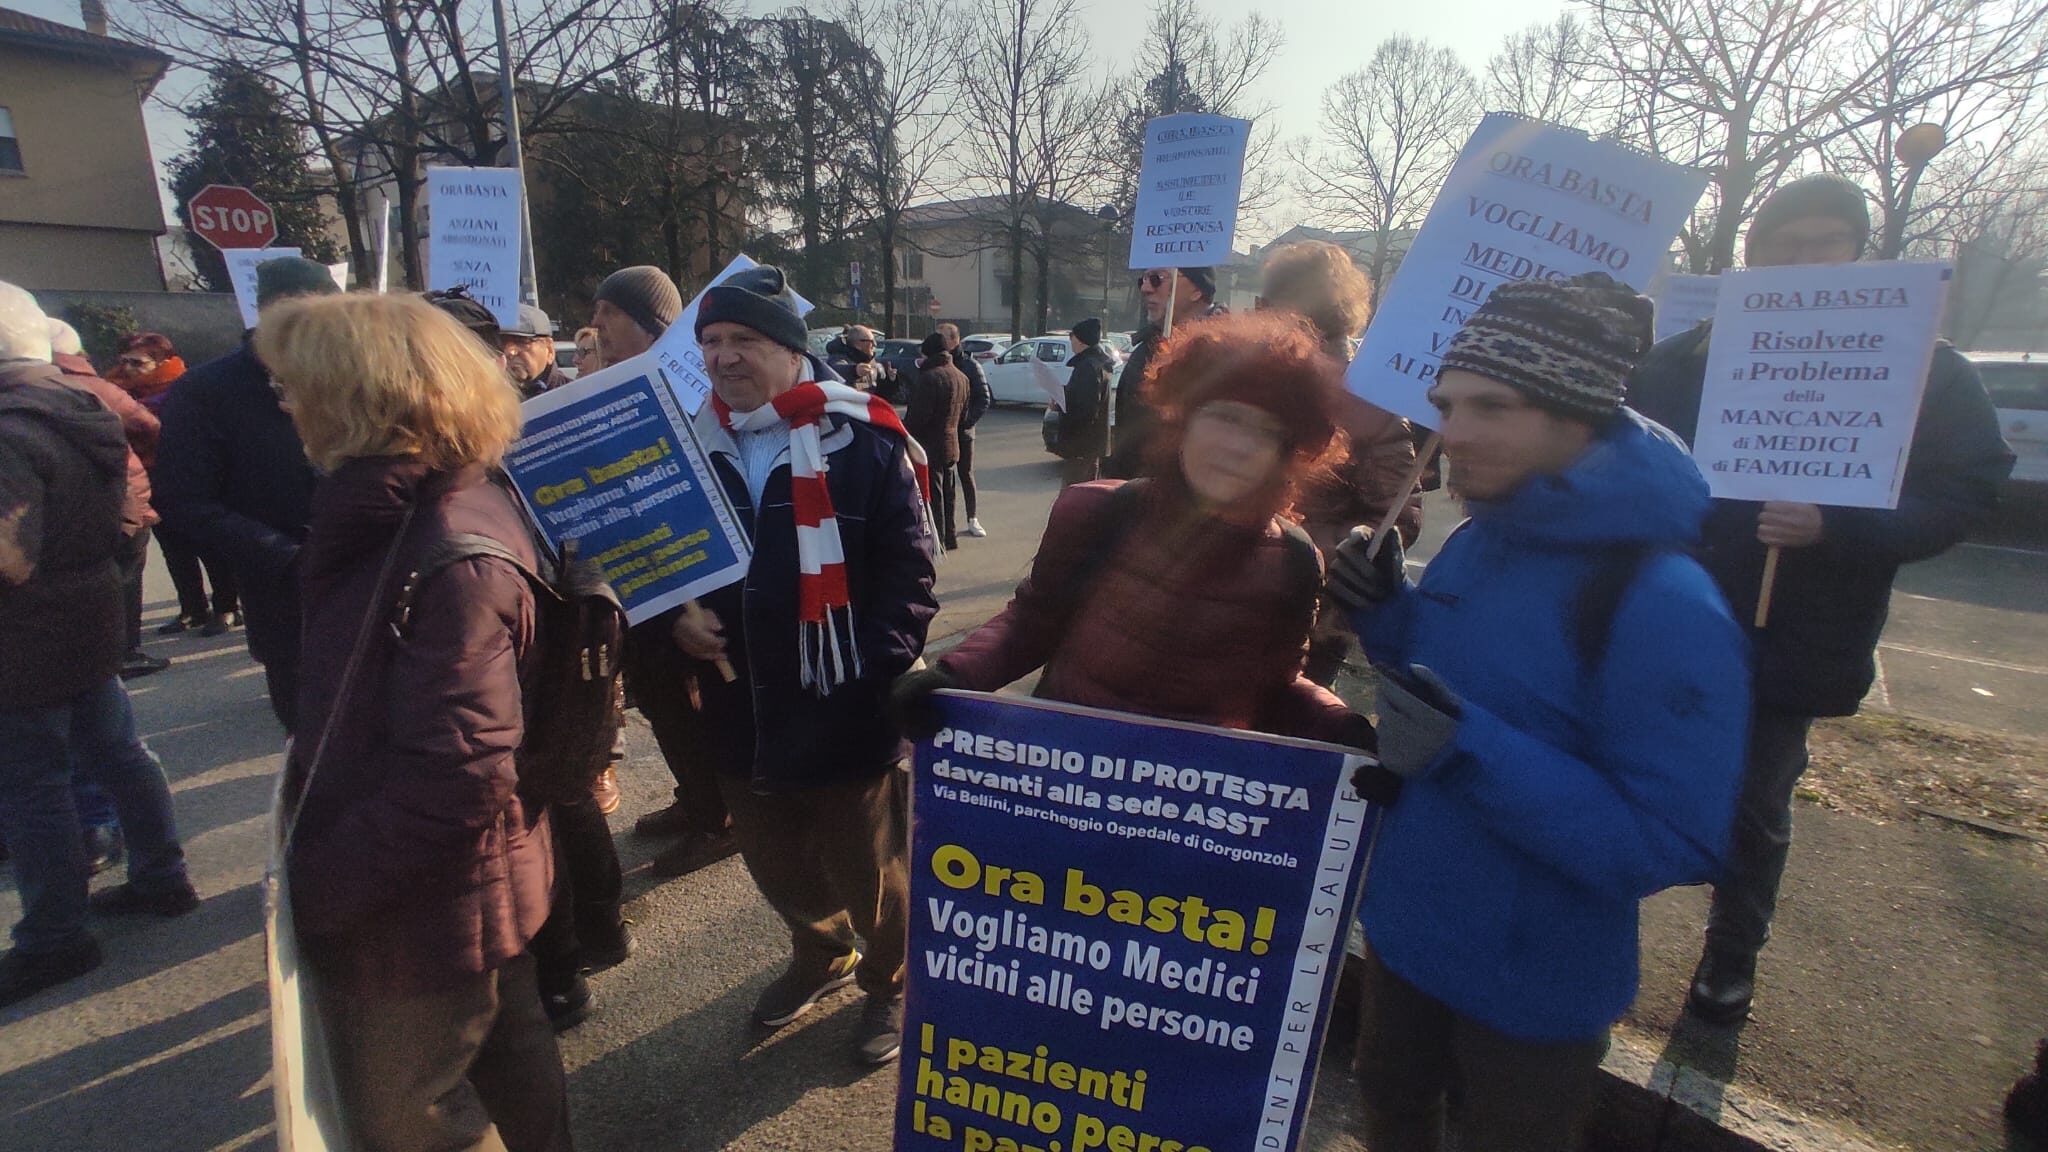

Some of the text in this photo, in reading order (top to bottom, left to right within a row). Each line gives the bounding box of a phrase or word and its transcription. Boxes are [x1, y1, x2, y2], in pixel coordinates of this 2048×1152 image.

[464, 184, 508, 198] BASTA
[1487, 149, 1653, 225] ORA BASTA
[196, 206, 270, 234] STOP
[1146, 221, 1225, 237] RESPONSA
[1466, 196, 1632, 271] VOGLIAMO
[1451, 274, 1488, 301] DI
[1743, 287, 1909, 309] ORA BASTA
[1750, 330, 1884, 350] Risolvete
[1385, 352, 1416, 375] AI
[1750, 361, 1890, 382] Problema
[1783, 389, 1825, 403] della
[1720, 408, 1884, 428] MANCANZA
[1732, 435, 1860, 453] di MEDICI
[536, 477, 588, 506] Ora
[587, 436, 672, 484] basta!
[1712, 458, 1873, 479] di FAMIGLIA
[933, 727, 1310, 811] PRESIDIO DI PROTESTA
[933, 759, 1270, 837] davanti alla sede ASST
[933, 784, 1297, 868] Via Bellini, parcheggio Ospedale di Gorgonzola
[931, 844, 1276, 955] Ora basta!
[1283, 1001, 1312, 1054] PER
[1301, 942, 1325, 975] LA
[1315, 790, 1361, 918] SALUTE
[928, 897, 1261, 1004] Vogliamo Medici
[926, 946, 1255, 1052] vicini alle persone
[921, 1023, 1147, 1112] I pazienti
[916, 1057, 1062, 1134] hanno
[913, 1101, 952, 1141] la
